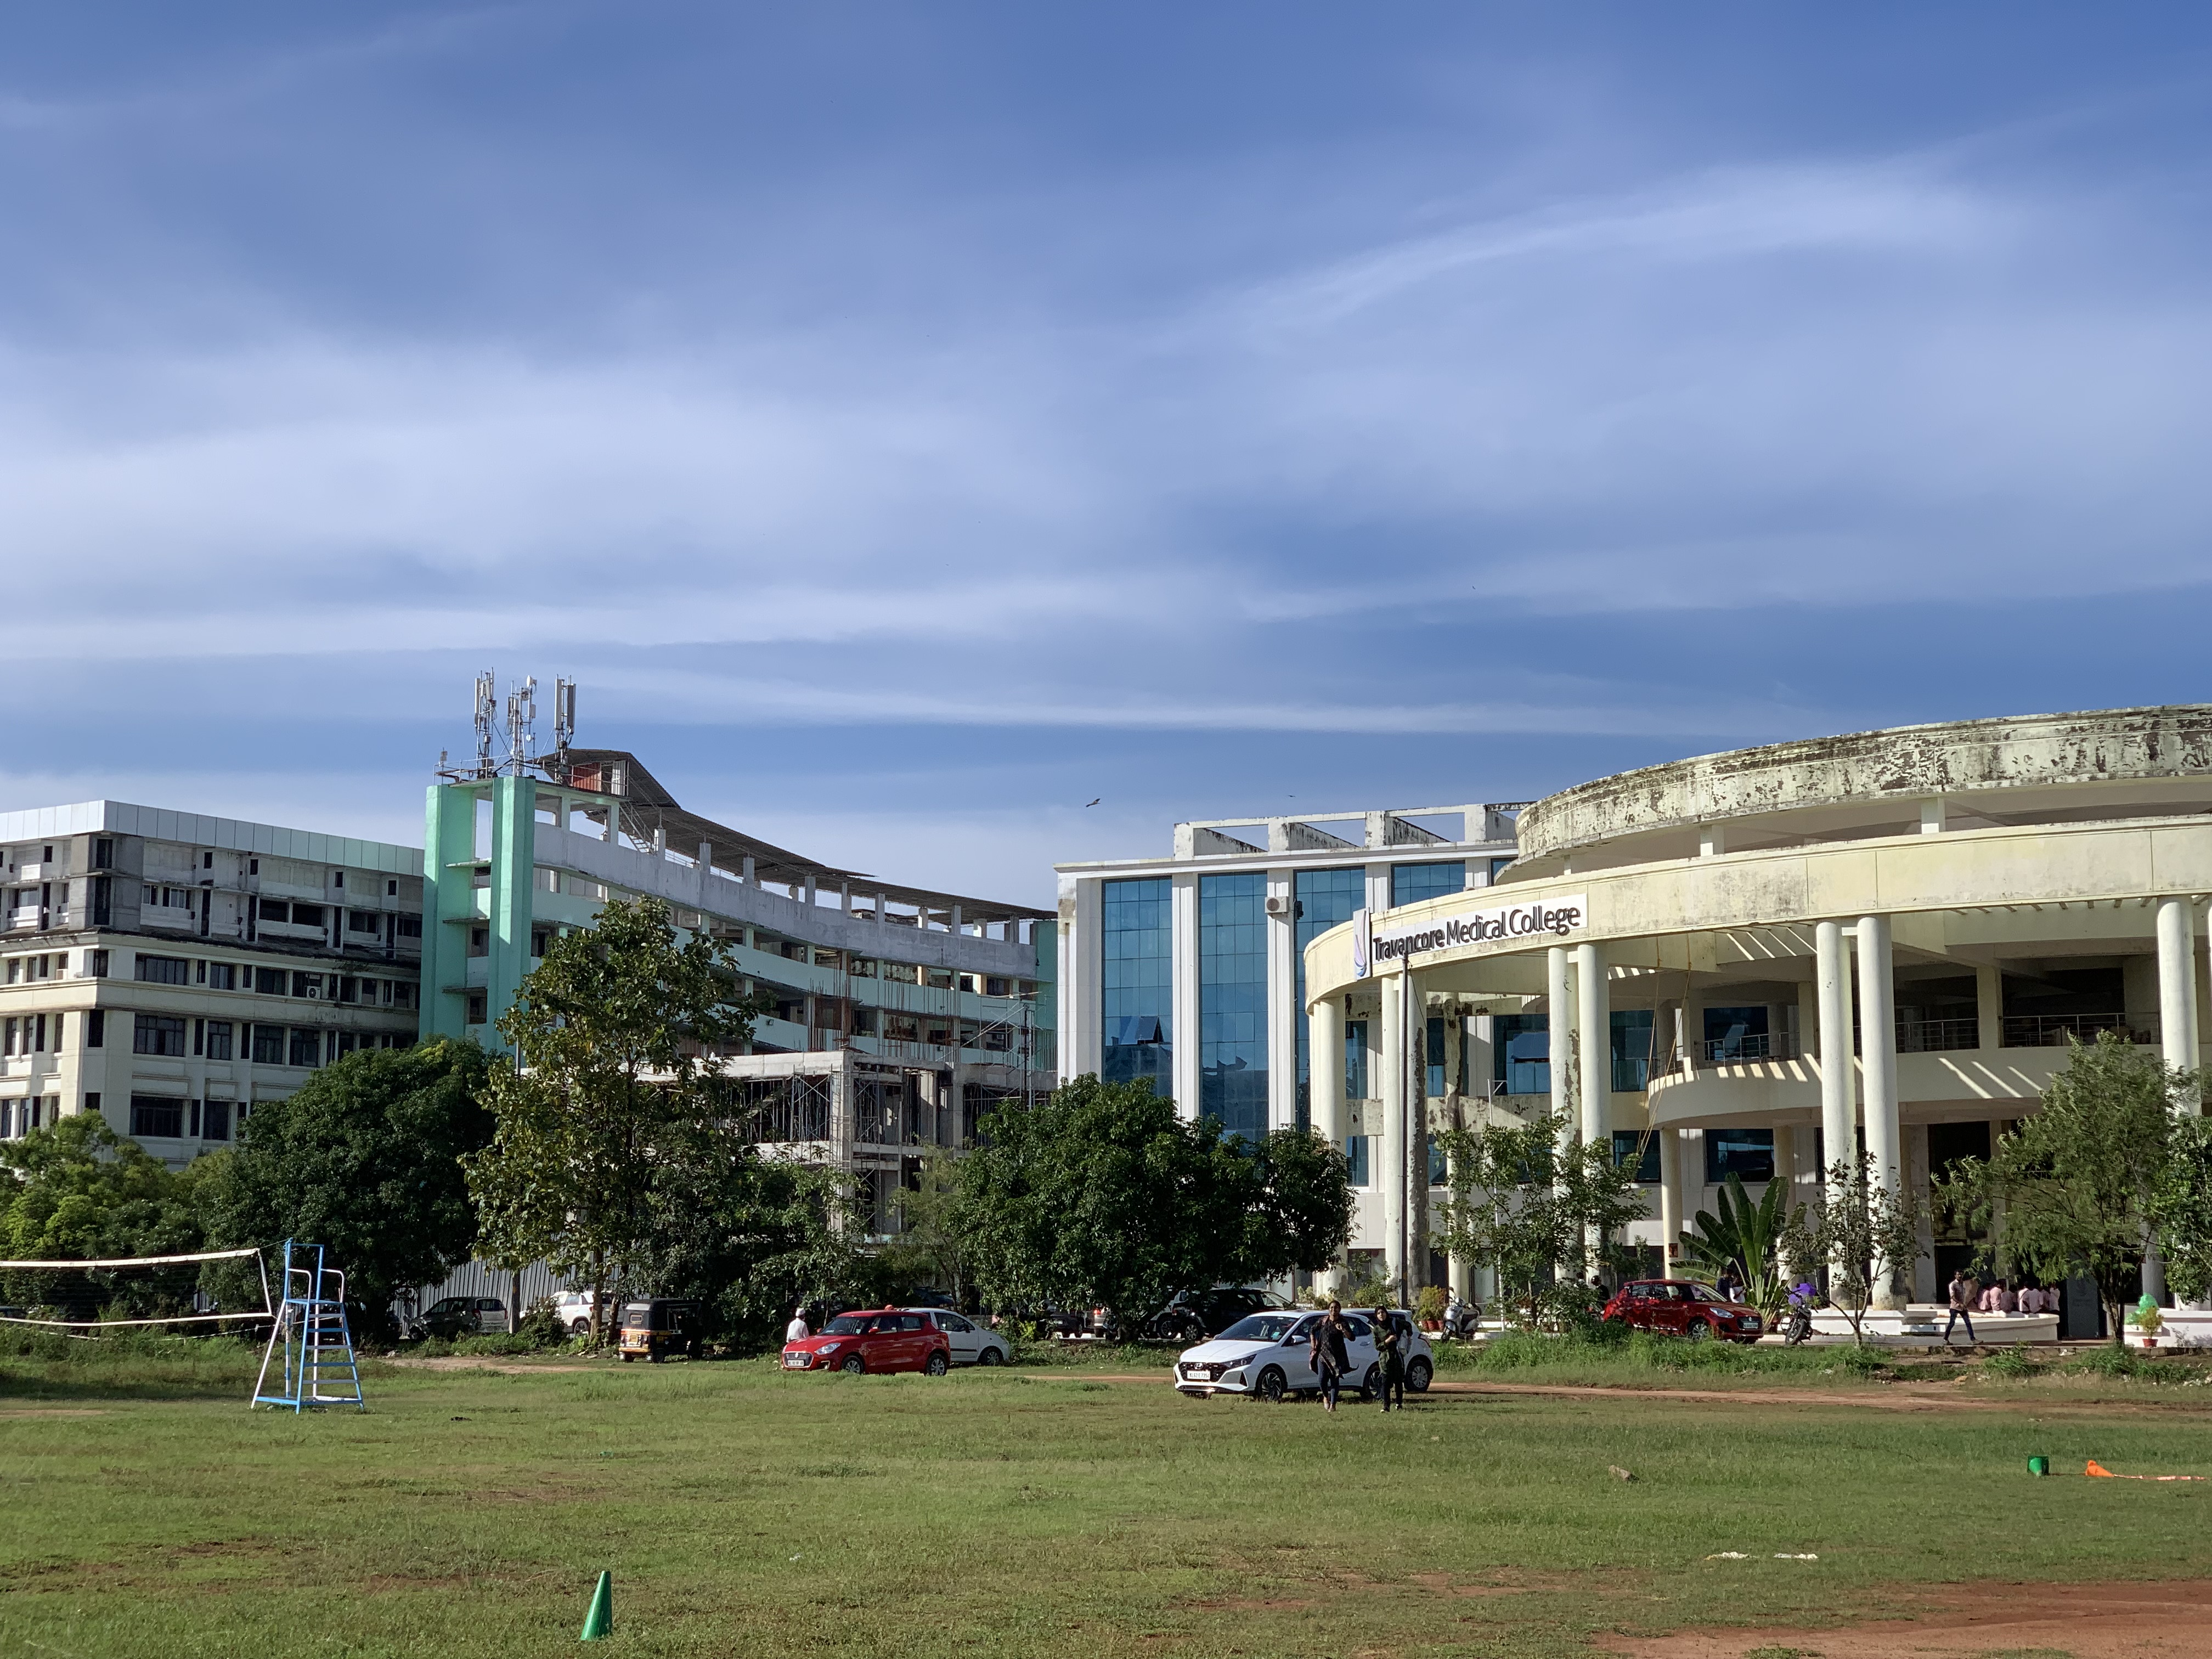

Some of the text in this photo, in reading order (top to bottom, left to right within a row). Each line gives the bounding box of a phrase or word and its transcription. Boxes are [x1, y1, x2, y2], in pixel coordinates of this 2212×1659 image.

[1373, 905, 1581, 961] Travancore Medical College
